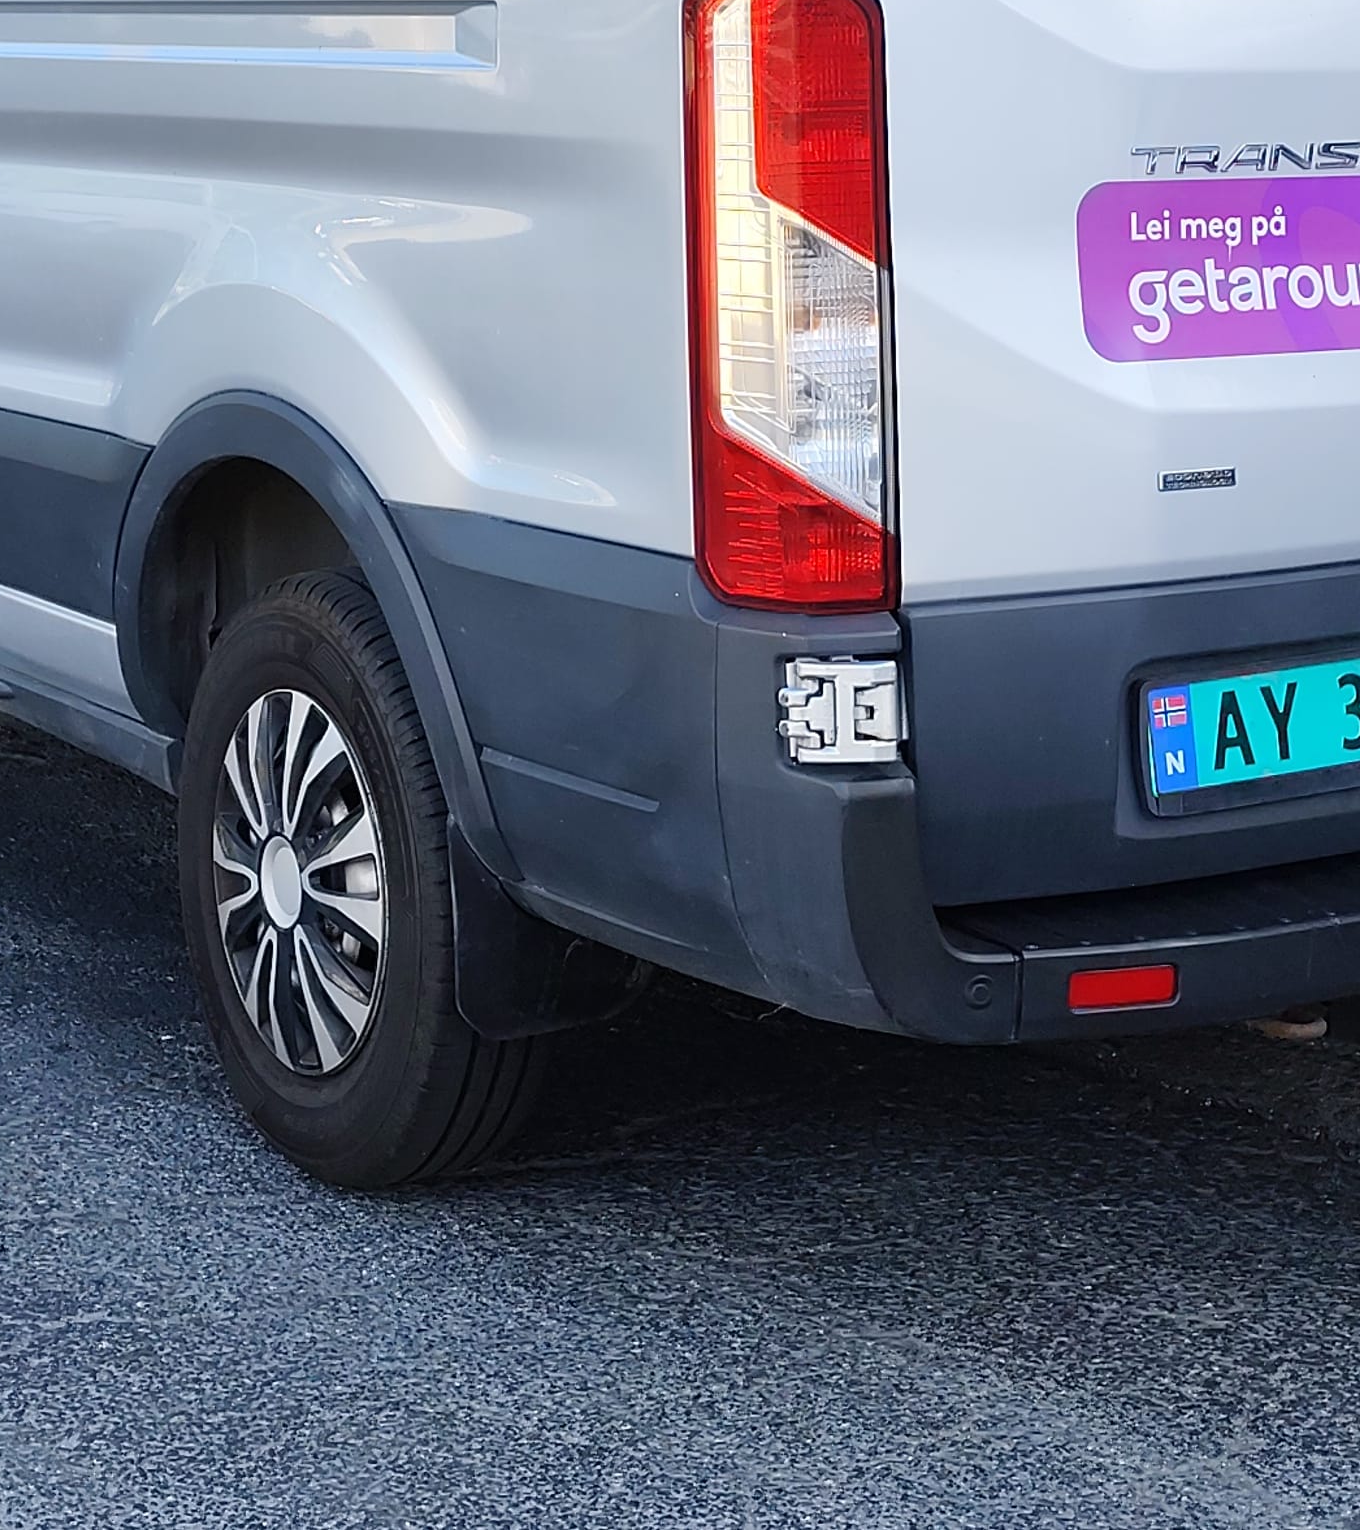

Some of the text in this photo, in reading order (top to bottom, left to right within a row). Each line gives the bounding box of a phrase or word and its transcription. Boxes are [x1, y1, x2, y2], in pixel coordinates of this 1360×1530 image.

[1129, 205, 1287, 247] Lei meg på
[1213, 681, 1298, 771] AY
[1165, 751, 1186, 776] N
